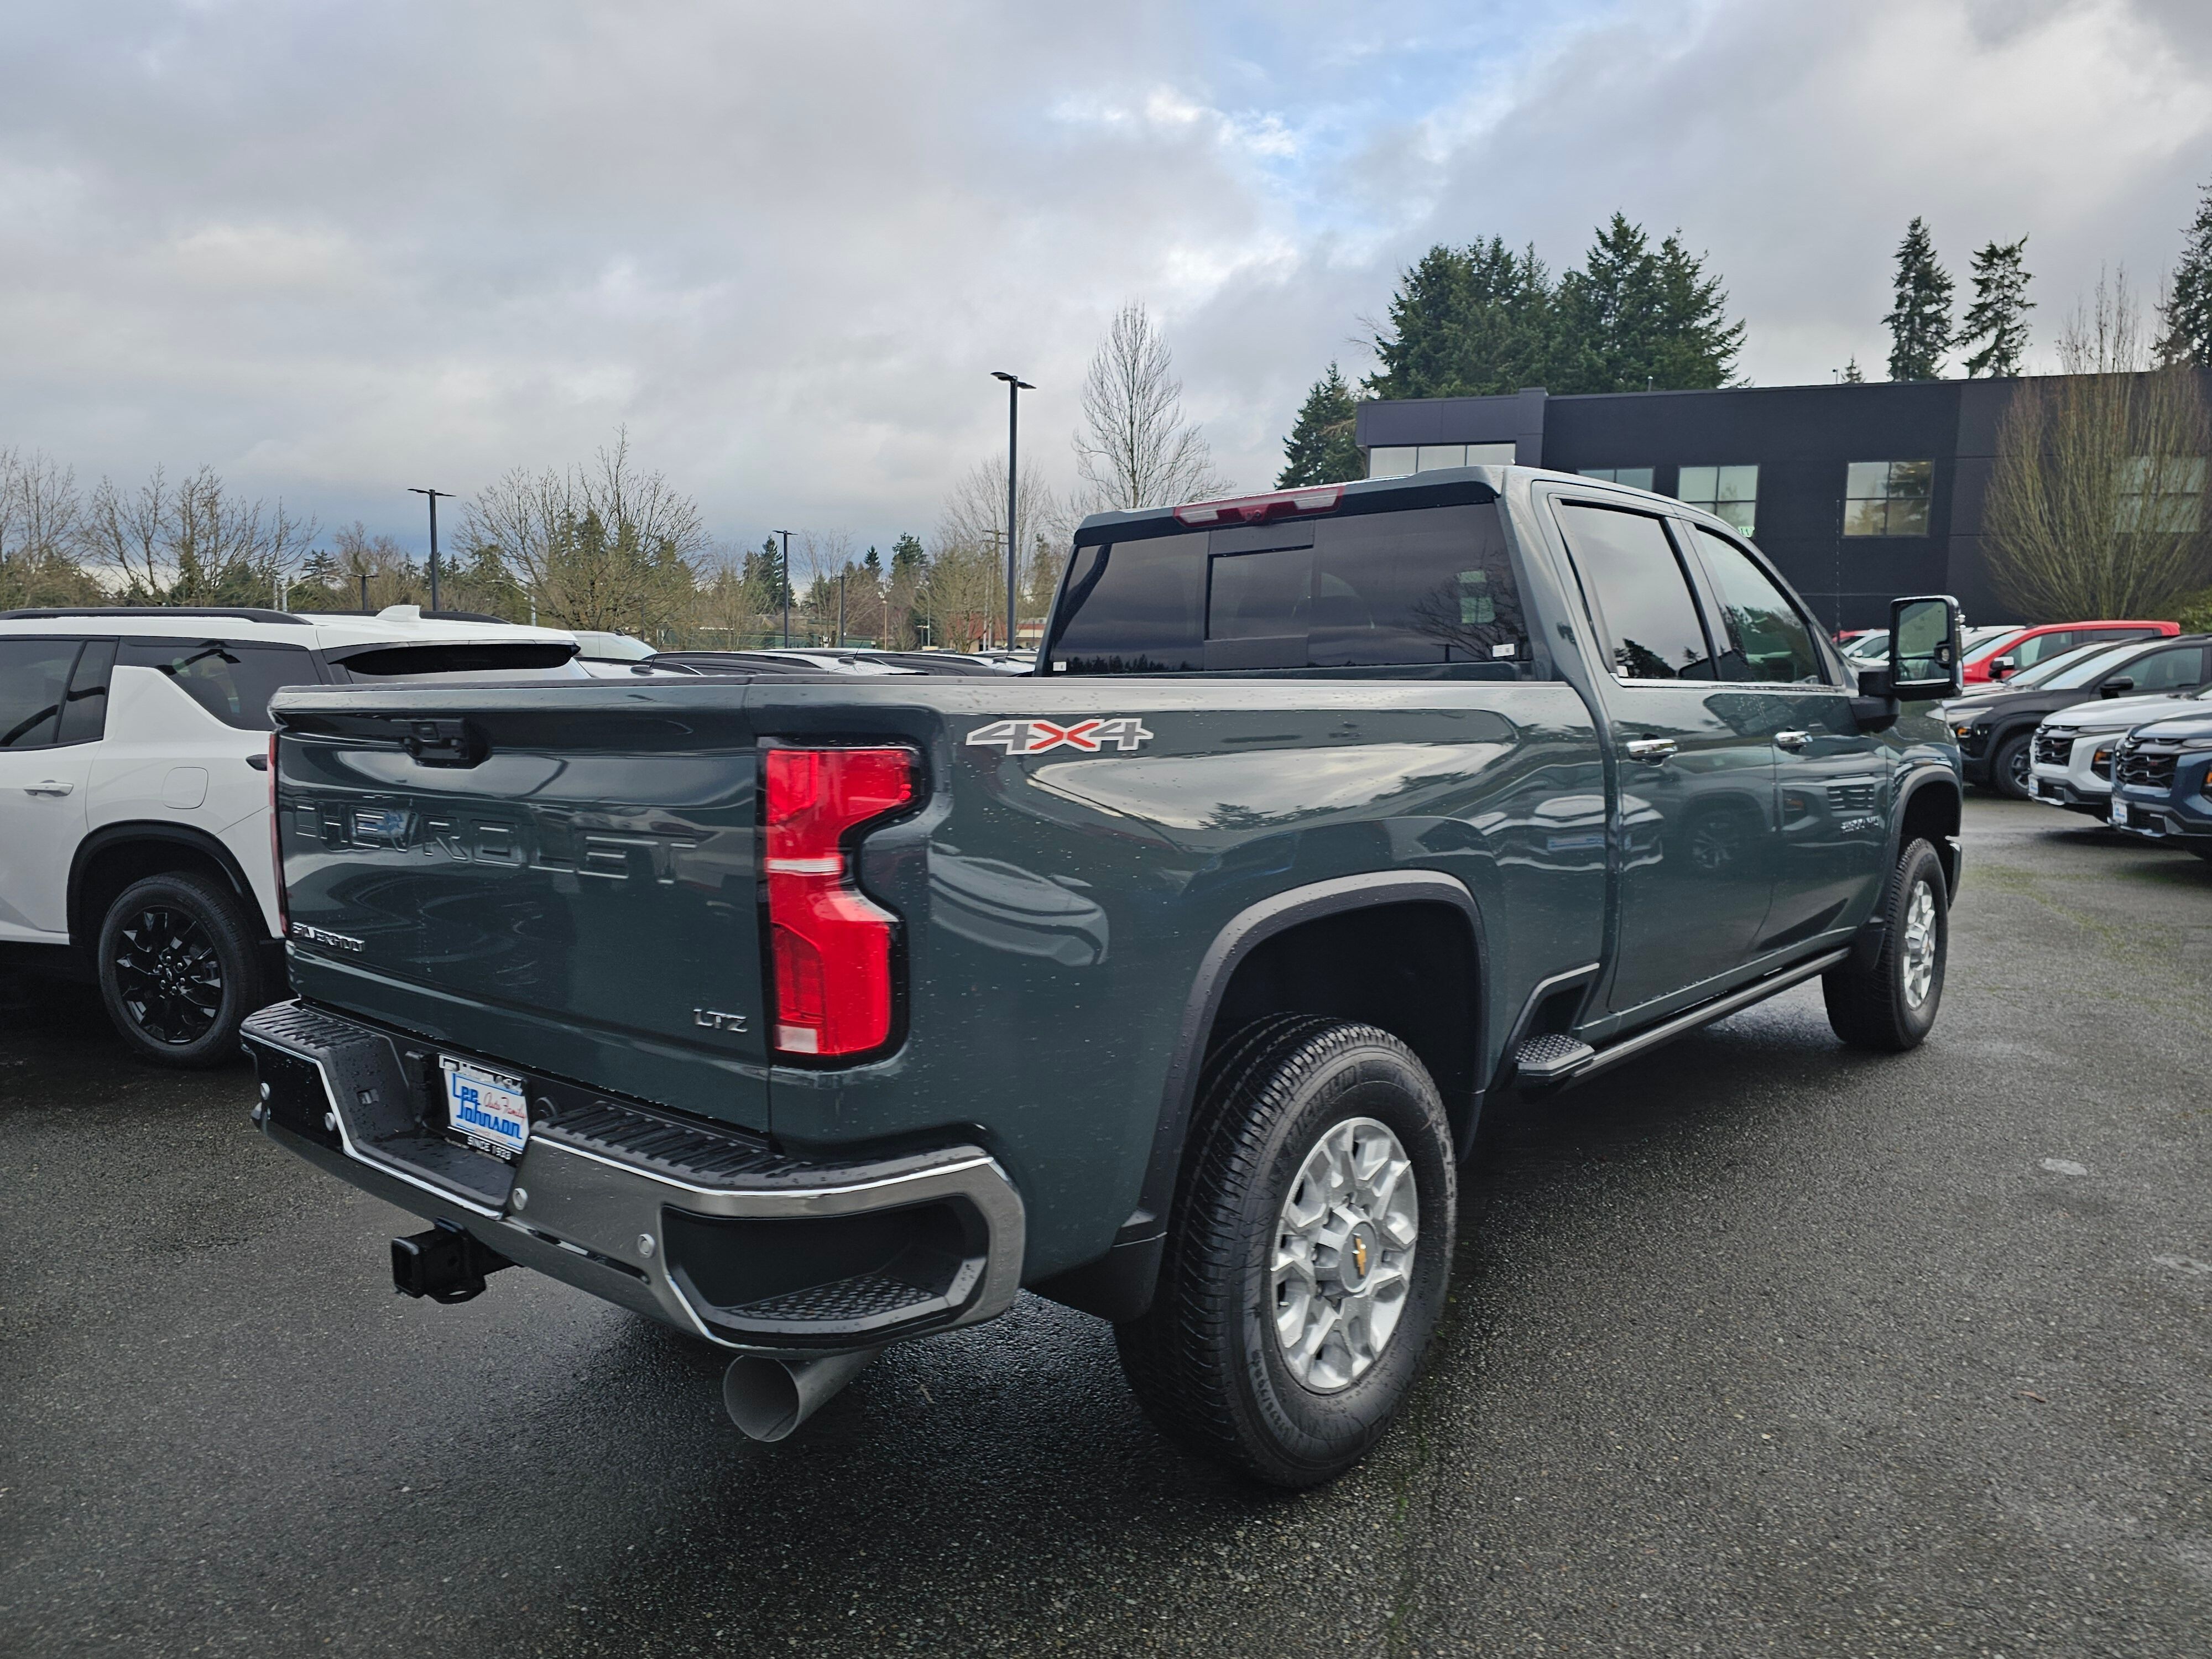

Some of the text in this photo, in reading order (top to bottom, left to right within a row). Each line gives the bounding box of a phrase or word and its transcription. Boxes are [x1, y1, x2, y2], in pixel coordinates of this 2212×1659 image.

[693, 1008, 748, 1032] LTZ
[452, 1073, 481, 1105] Lee
[456, 1098, 523, 1140] Johnson
[467, 1136, 490, 1152] SINCE
